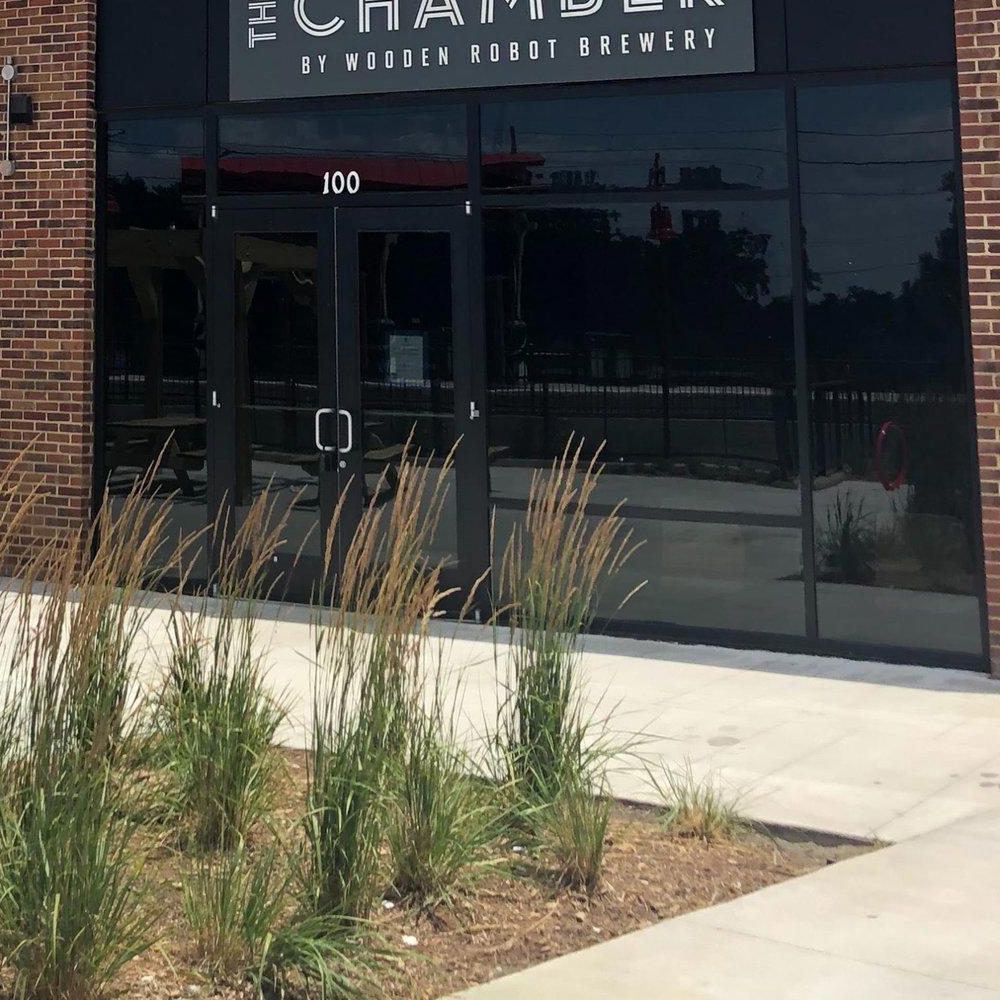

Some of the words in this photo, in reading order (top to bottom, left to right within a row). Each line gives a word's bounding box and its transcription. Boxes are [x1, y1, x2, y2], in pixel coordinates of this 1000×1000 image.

[301, 54, 327, 75] BY
[345, 46, 449, 72] WOODEN
[470, 38, 557, 64] ROBOT
[579, 28, 715, 57] BREWERY
[322, 170, 360, 195] 100
